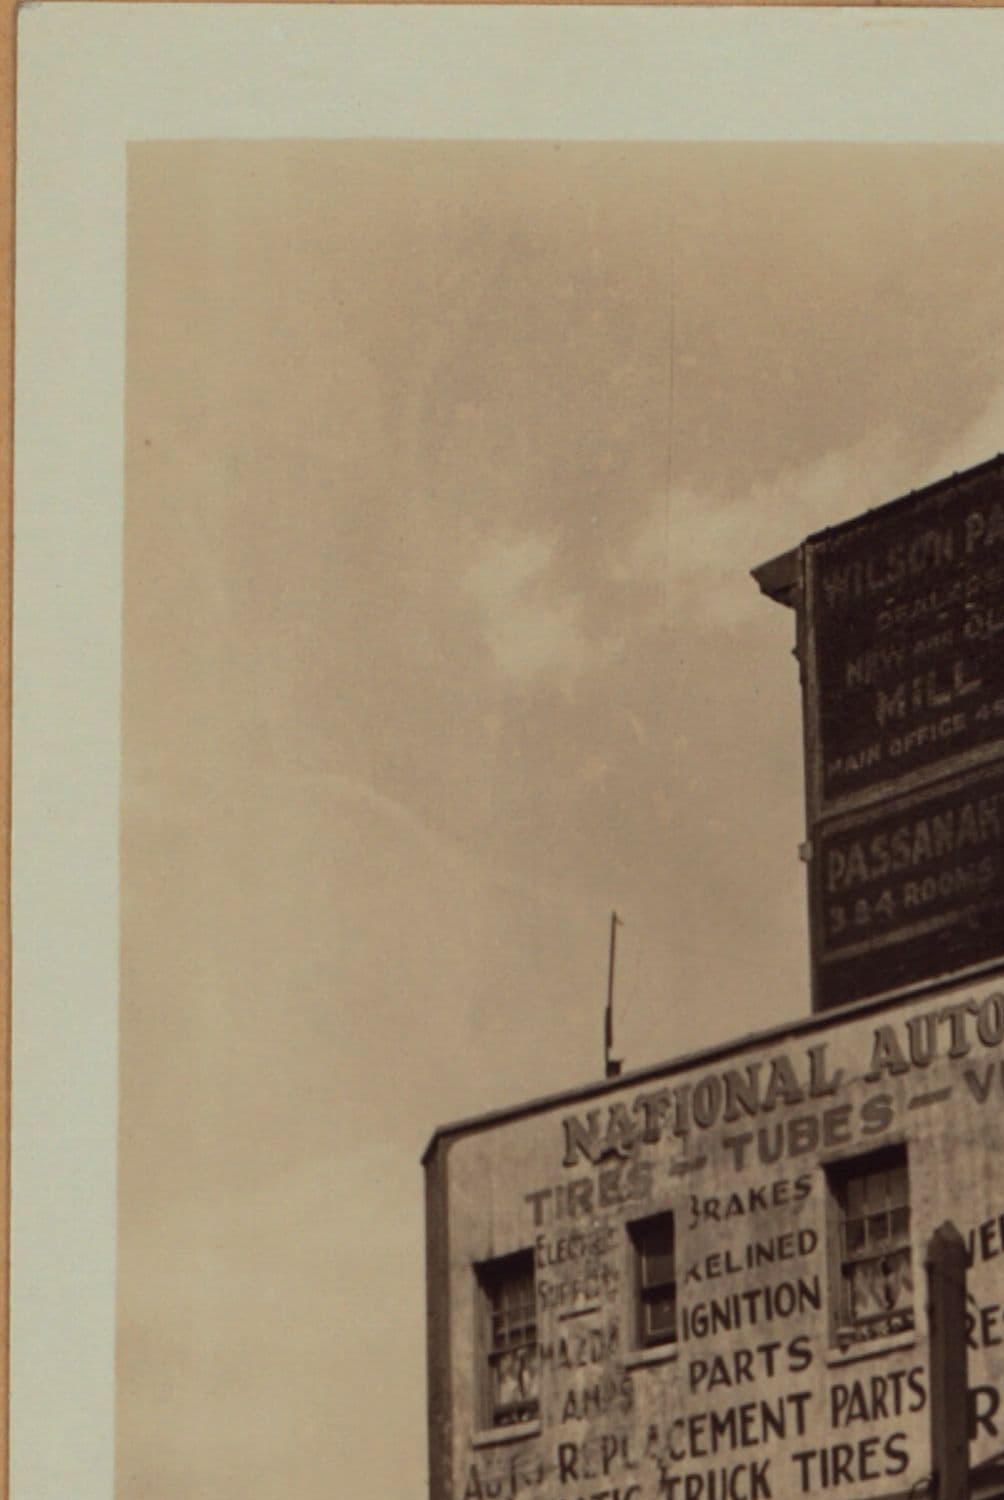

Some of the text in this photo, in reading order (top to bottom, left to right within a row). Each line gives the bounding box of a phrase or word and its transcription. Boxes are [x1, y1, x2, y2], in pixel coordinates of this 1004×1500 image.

[876, 661, 982, 729] MILL
[888, 711, 968, 758] OFFICE
[561, 1042, 848, 1168] NATIONAL
[524, 1158, 656, 1228] TIRES
[722, 1091, 896, 1174] TUBES
[682, 1274, 823, 1343] IGNITION
[689, 1335, 815, 1395] PARTS
[558, 1391, 812, 1486] REPLACEMENT
[831, 1366, 928, 1430] PARTS
[792, 1433, 911, 1494] TIRES
